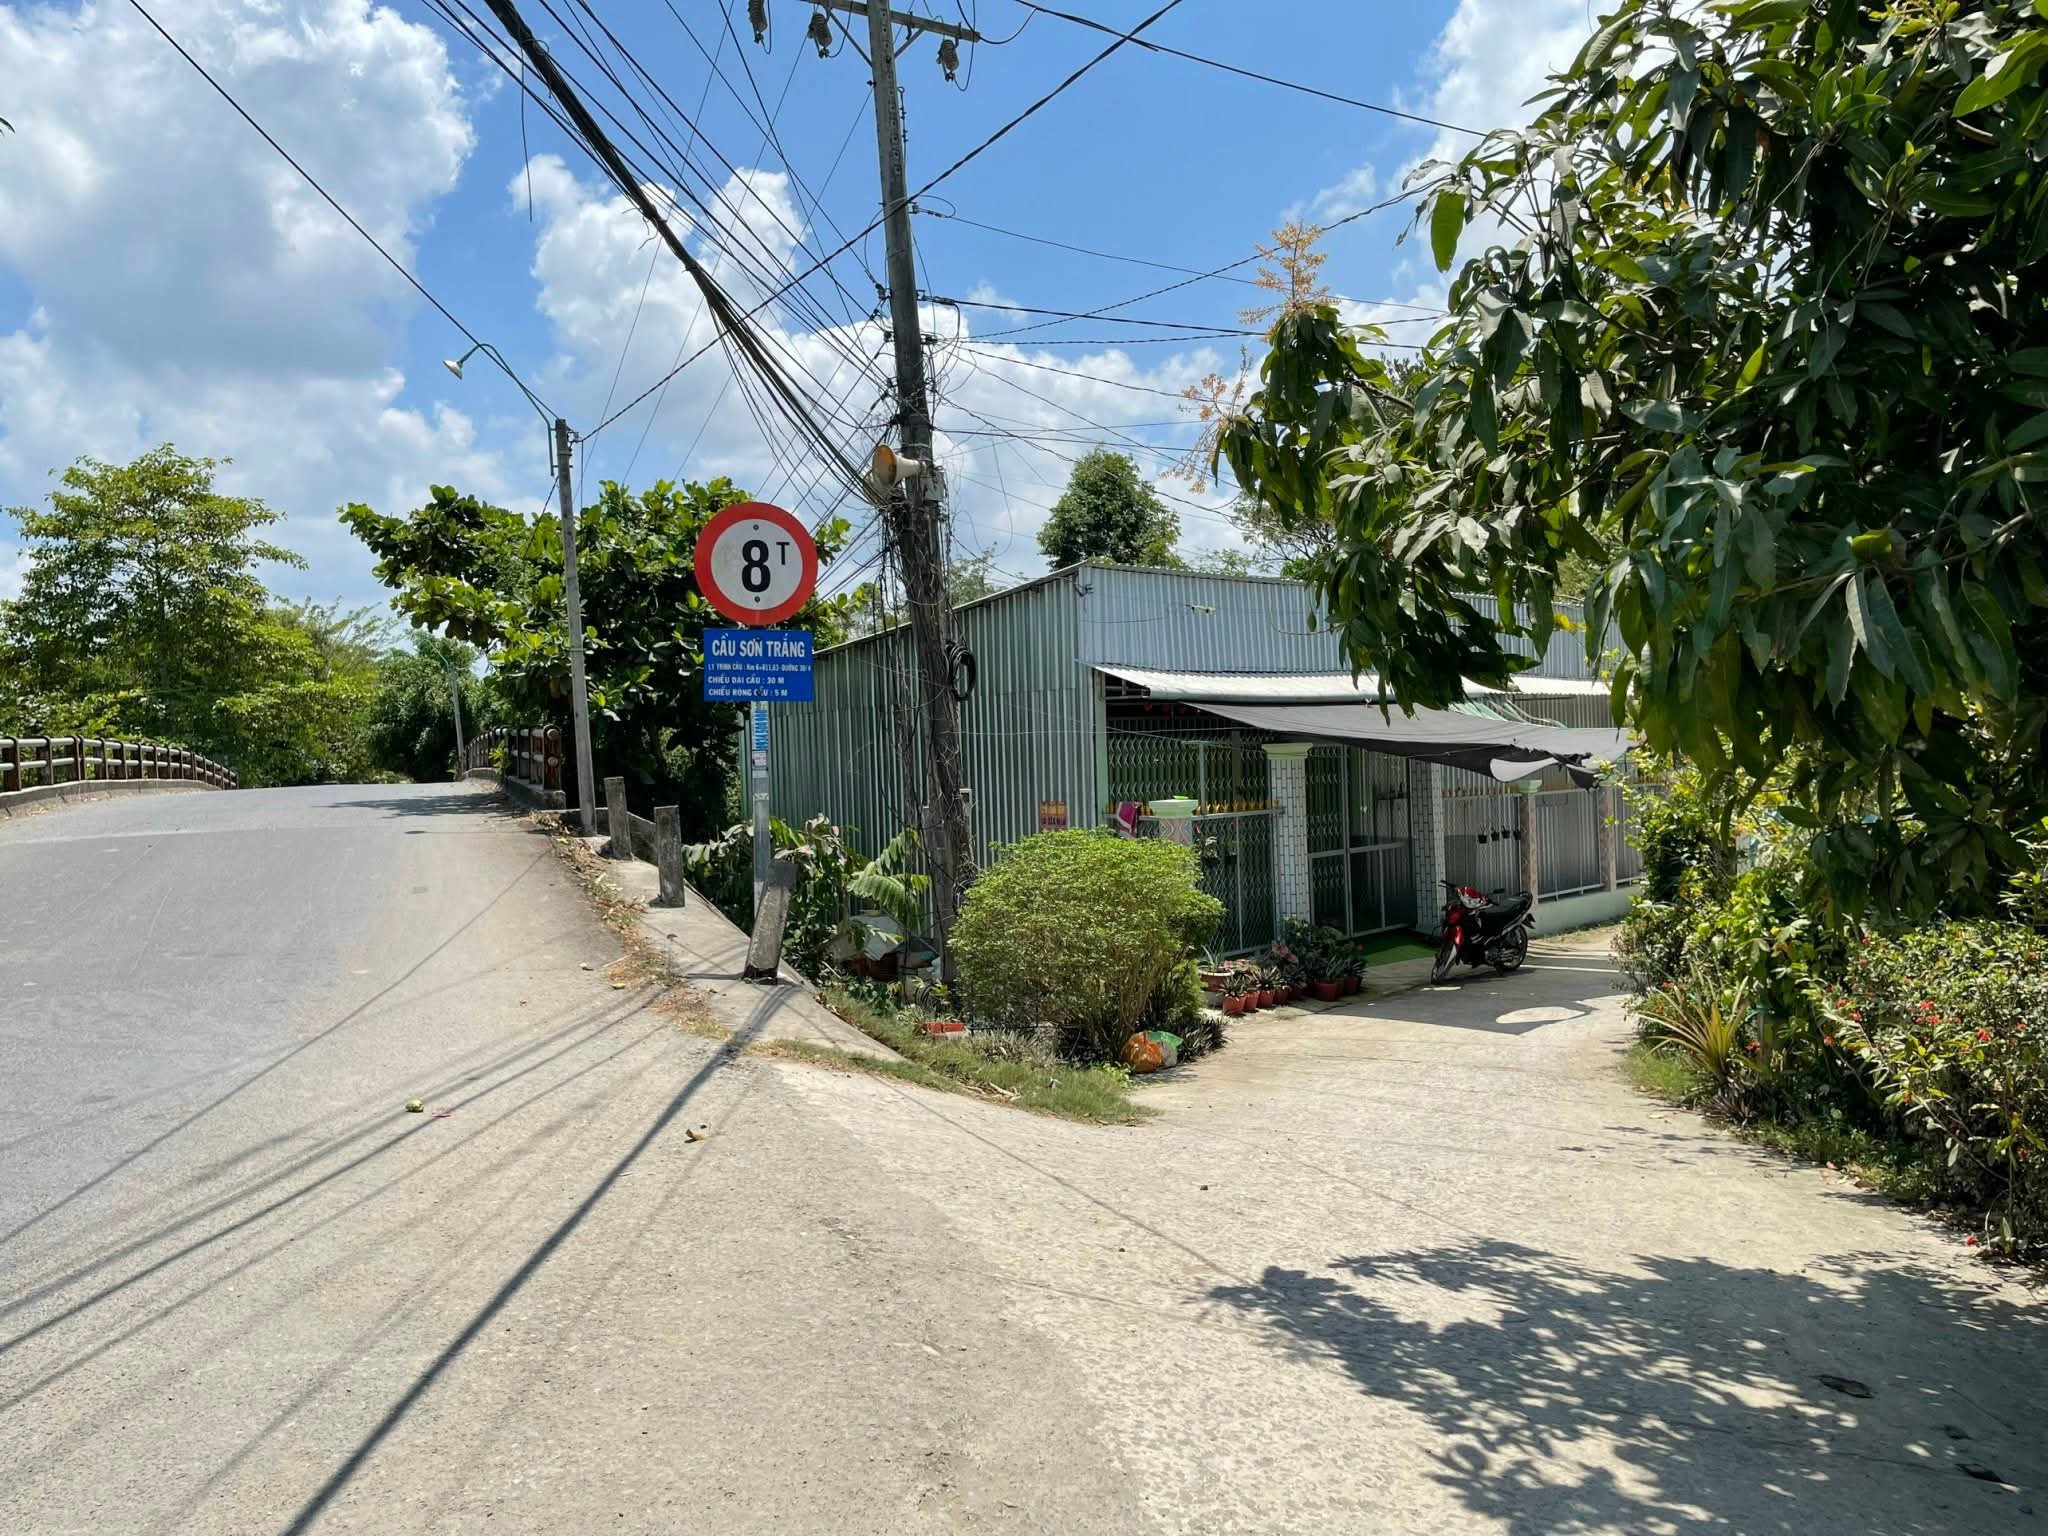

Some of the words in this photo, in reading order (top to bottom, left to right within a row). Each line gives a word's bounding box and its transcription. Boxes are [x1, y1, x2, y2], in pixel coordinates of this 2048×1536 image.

[742, 540, 771, 593] 8
[776, 542, 790, 565] T
[712, 633, 736, 656] CẦU
[766, 633, 805, 658] TRẮNG
